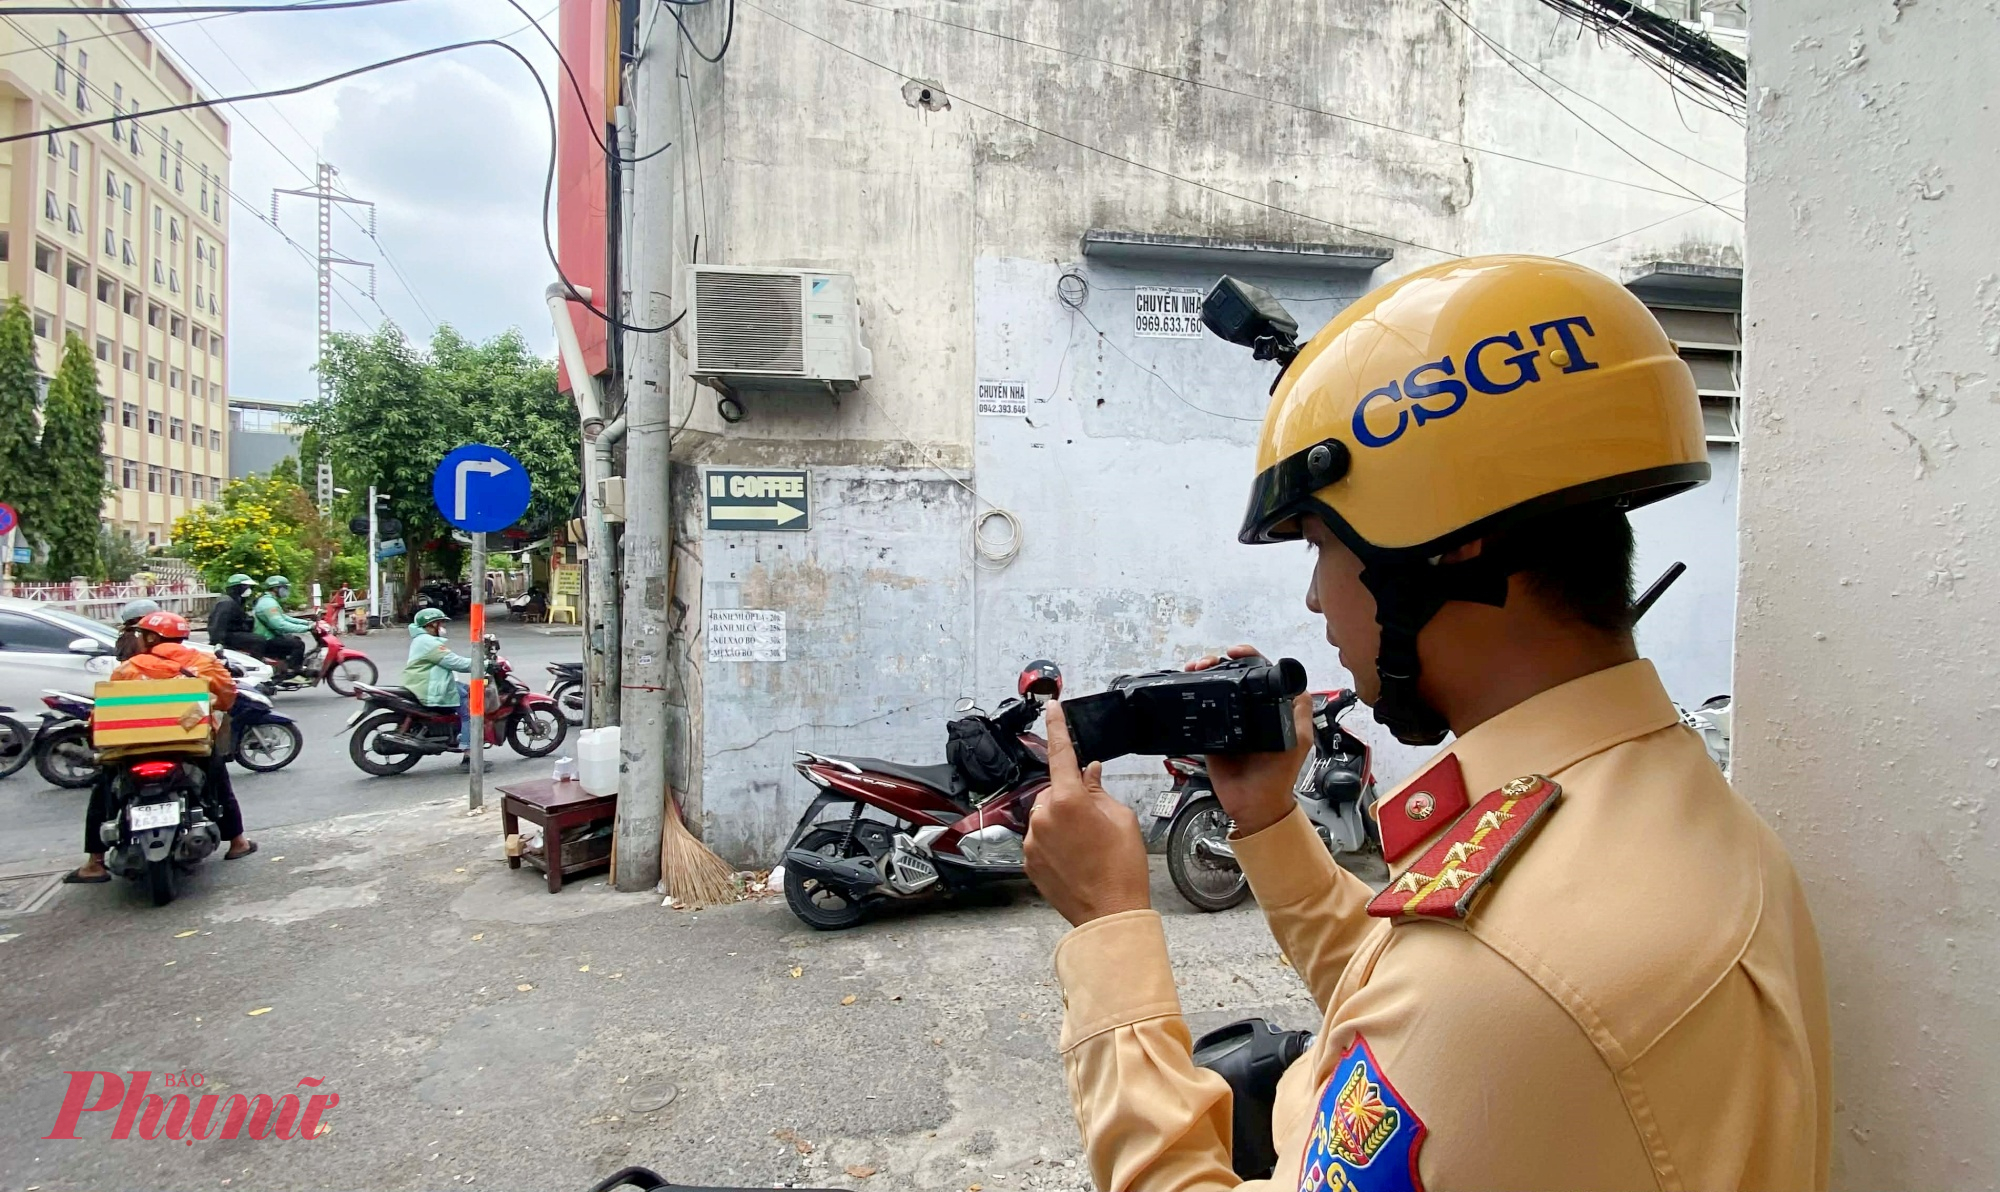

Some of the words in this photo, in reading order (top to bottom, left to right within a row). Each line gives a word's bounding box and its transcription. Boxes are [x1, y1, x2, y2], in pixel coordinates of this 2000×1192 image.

[1136, 316, 1202, 333] 0969.633.760
[1352, 316, 1599, 448] CSGT
[979, 404, 1026, 414] 0942.393.646
[710, 475, 726, 498] H
[730, 475, 805, 498] COFFEE
